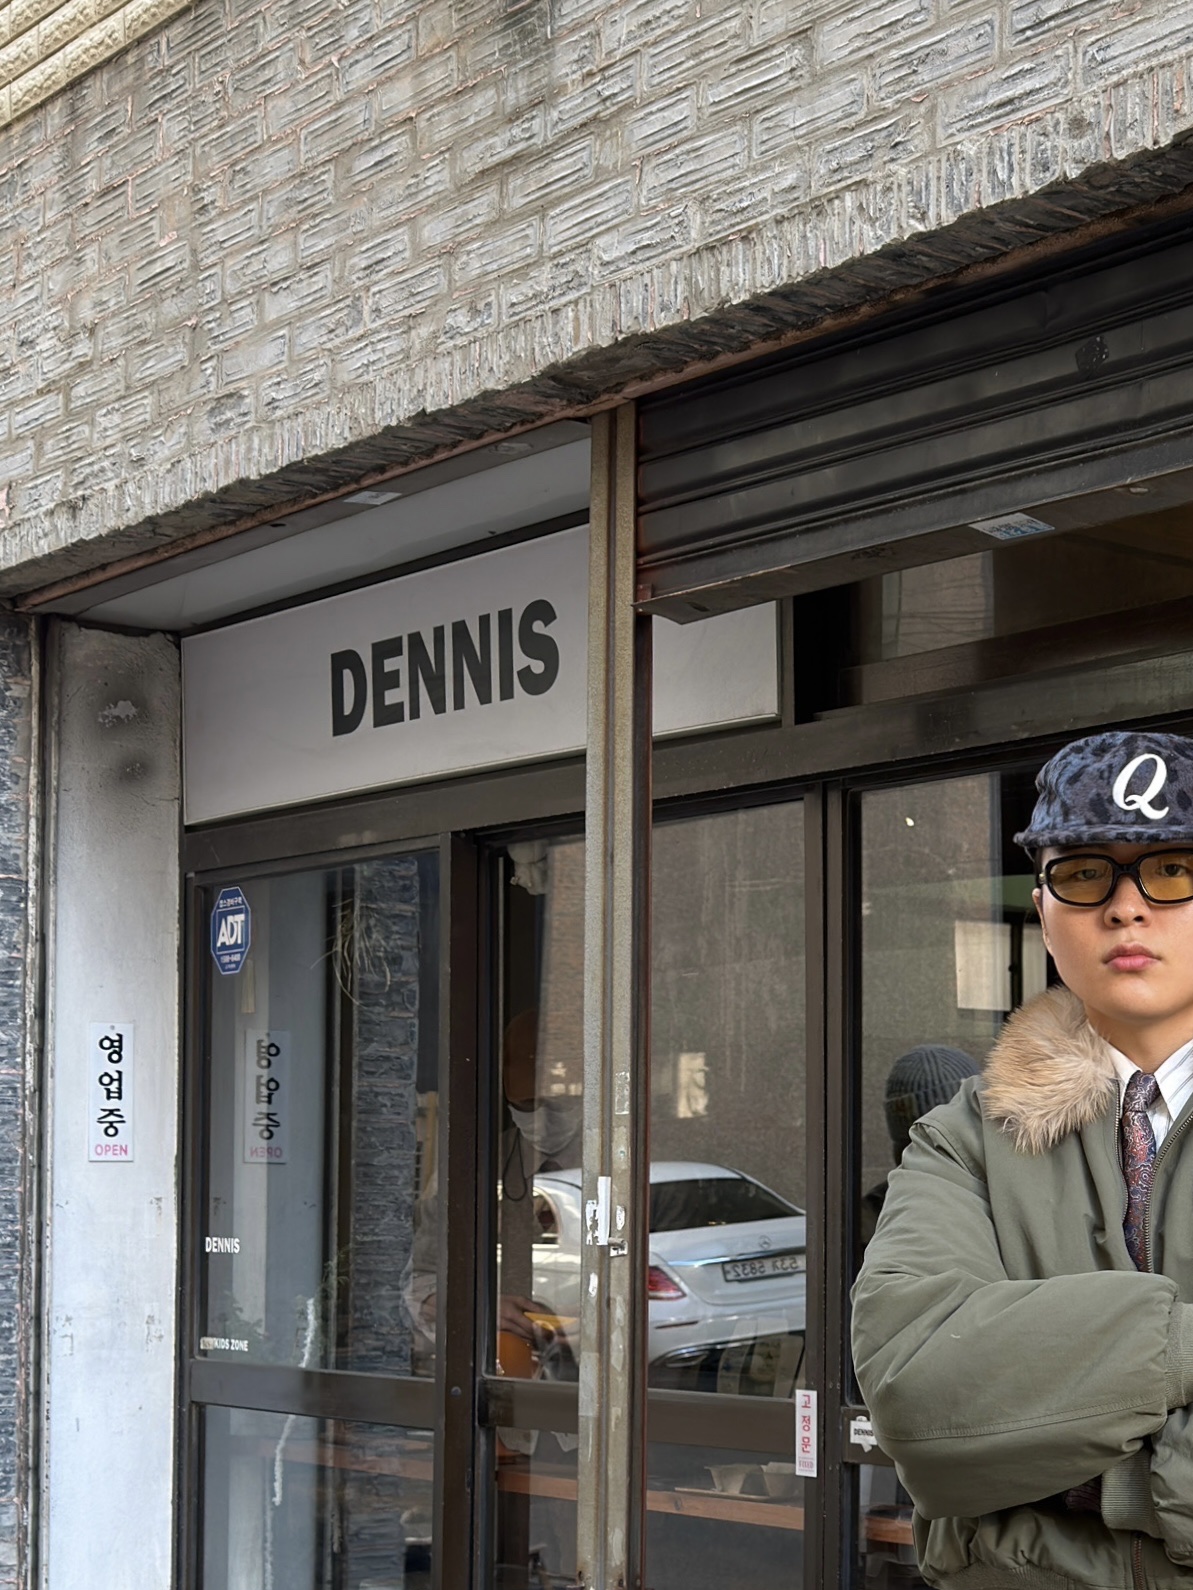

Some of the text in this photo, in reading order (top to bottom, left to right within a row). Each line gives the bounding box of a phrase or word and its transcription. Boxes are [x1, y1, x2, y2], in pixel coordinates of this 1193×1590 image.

[331, 599, 560, 737] DENNIS
[1112, 753, 1169, 819] Q
[216, 914, 245, 947] ADT
[97, 1033, 126, 1138] 영업중
[95, 1143, 128, 1156] OPEN
[205, 1237, 240, 1253] DENNIS
[230, 1339, 249, 1352] ZONE
[801, 1394, 811, 1454] 고정문
